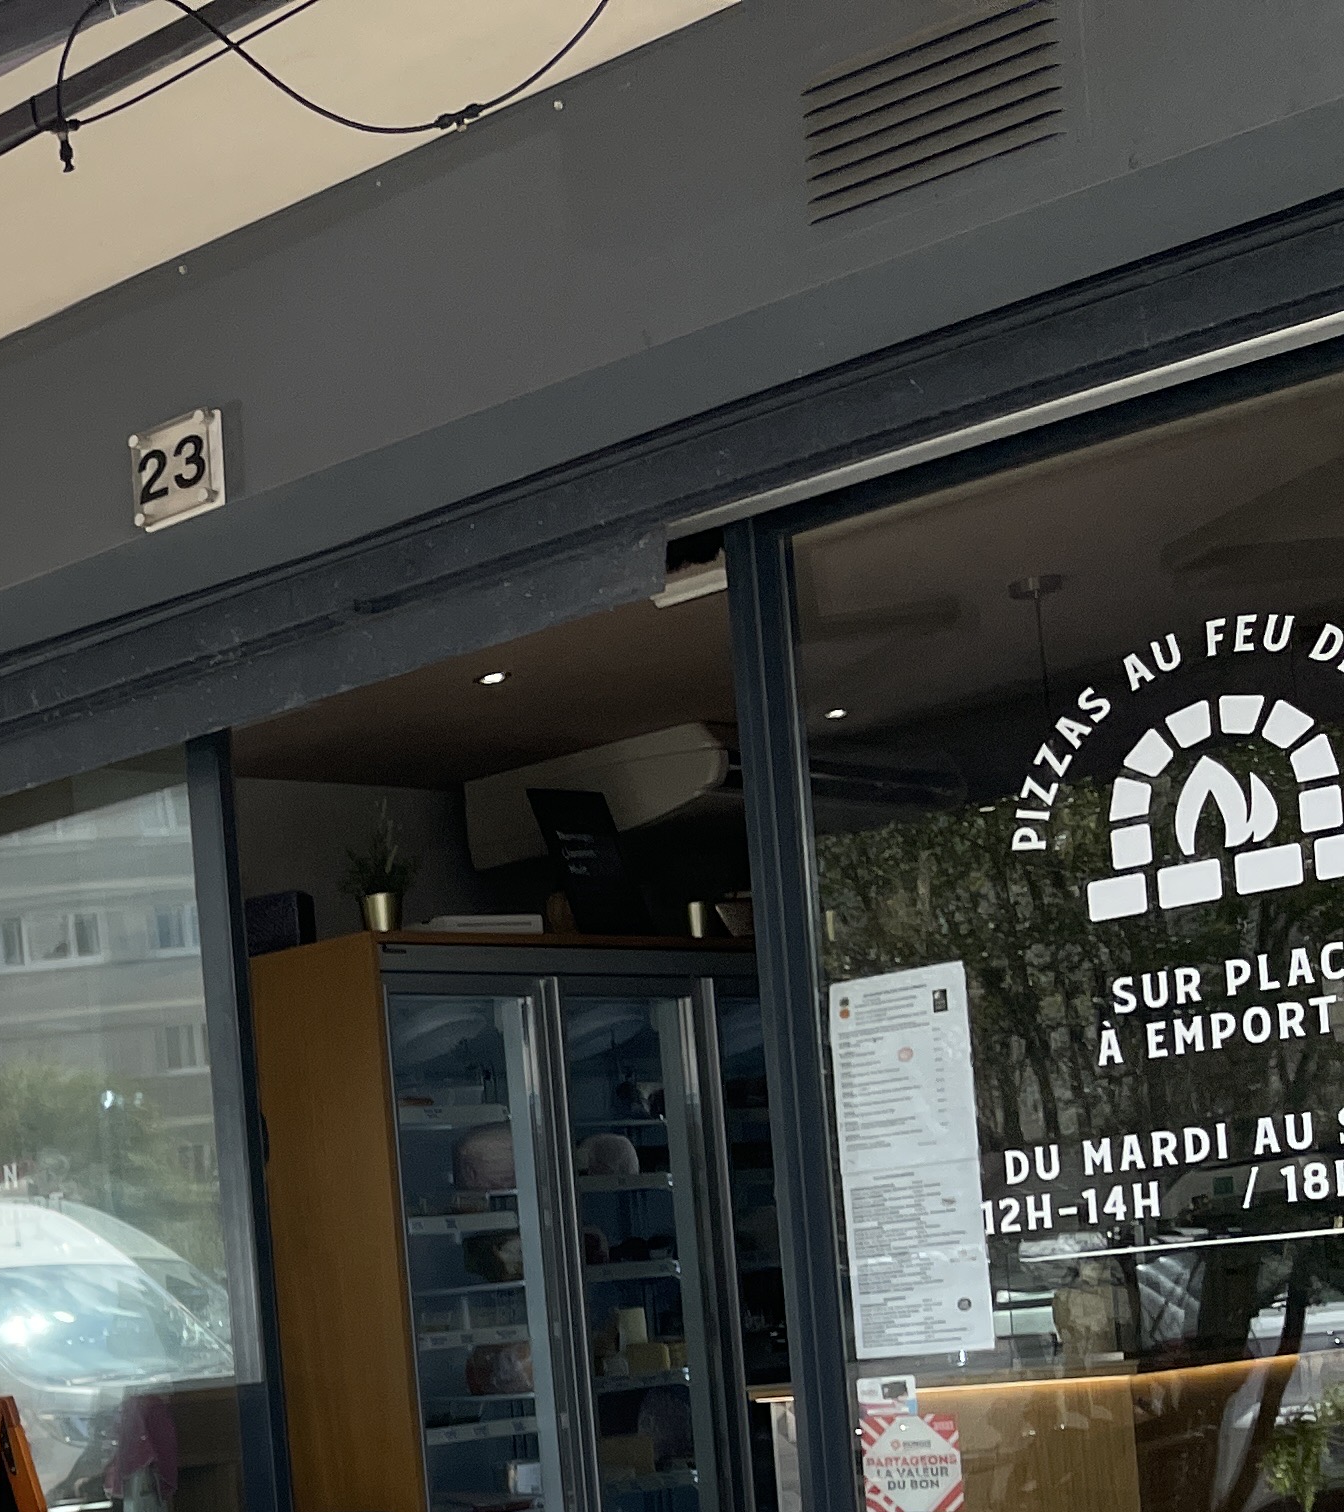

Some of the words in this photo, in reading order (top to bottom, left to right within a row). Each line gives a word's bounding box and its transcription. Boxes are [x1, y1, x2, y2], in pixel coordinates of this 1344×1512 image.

[138, 434, 205, 505] 23
[1011, 687, 1111, 851] PIZZAS
[1123, 633, 1181, 691] AU
[1206, 614, 1295, 657] FEU
[1308, 622, 1344, 673] D
[1112, 967, 1202, 1015] SUR
[1098, 1020, 1124, 1066] À
[1146, 994, 1337, 1059] EMPORT
[1004, 1144, 1060, 1185] DU
[1082, 1122, 1229, 1176] MARDI
[1254, 1111, 1313, 1155] AU
[980, 1180, 1161, 1236] 12H-14H
[866, 1454, 957, 1467] PARTAGEONS
[877, 1468, 893, 1478] LA
[897, 1466, 949, 1478] VALEUR
[887, 1480, 905, 1490] DU
[910, 1479, 940, 1490] BON
